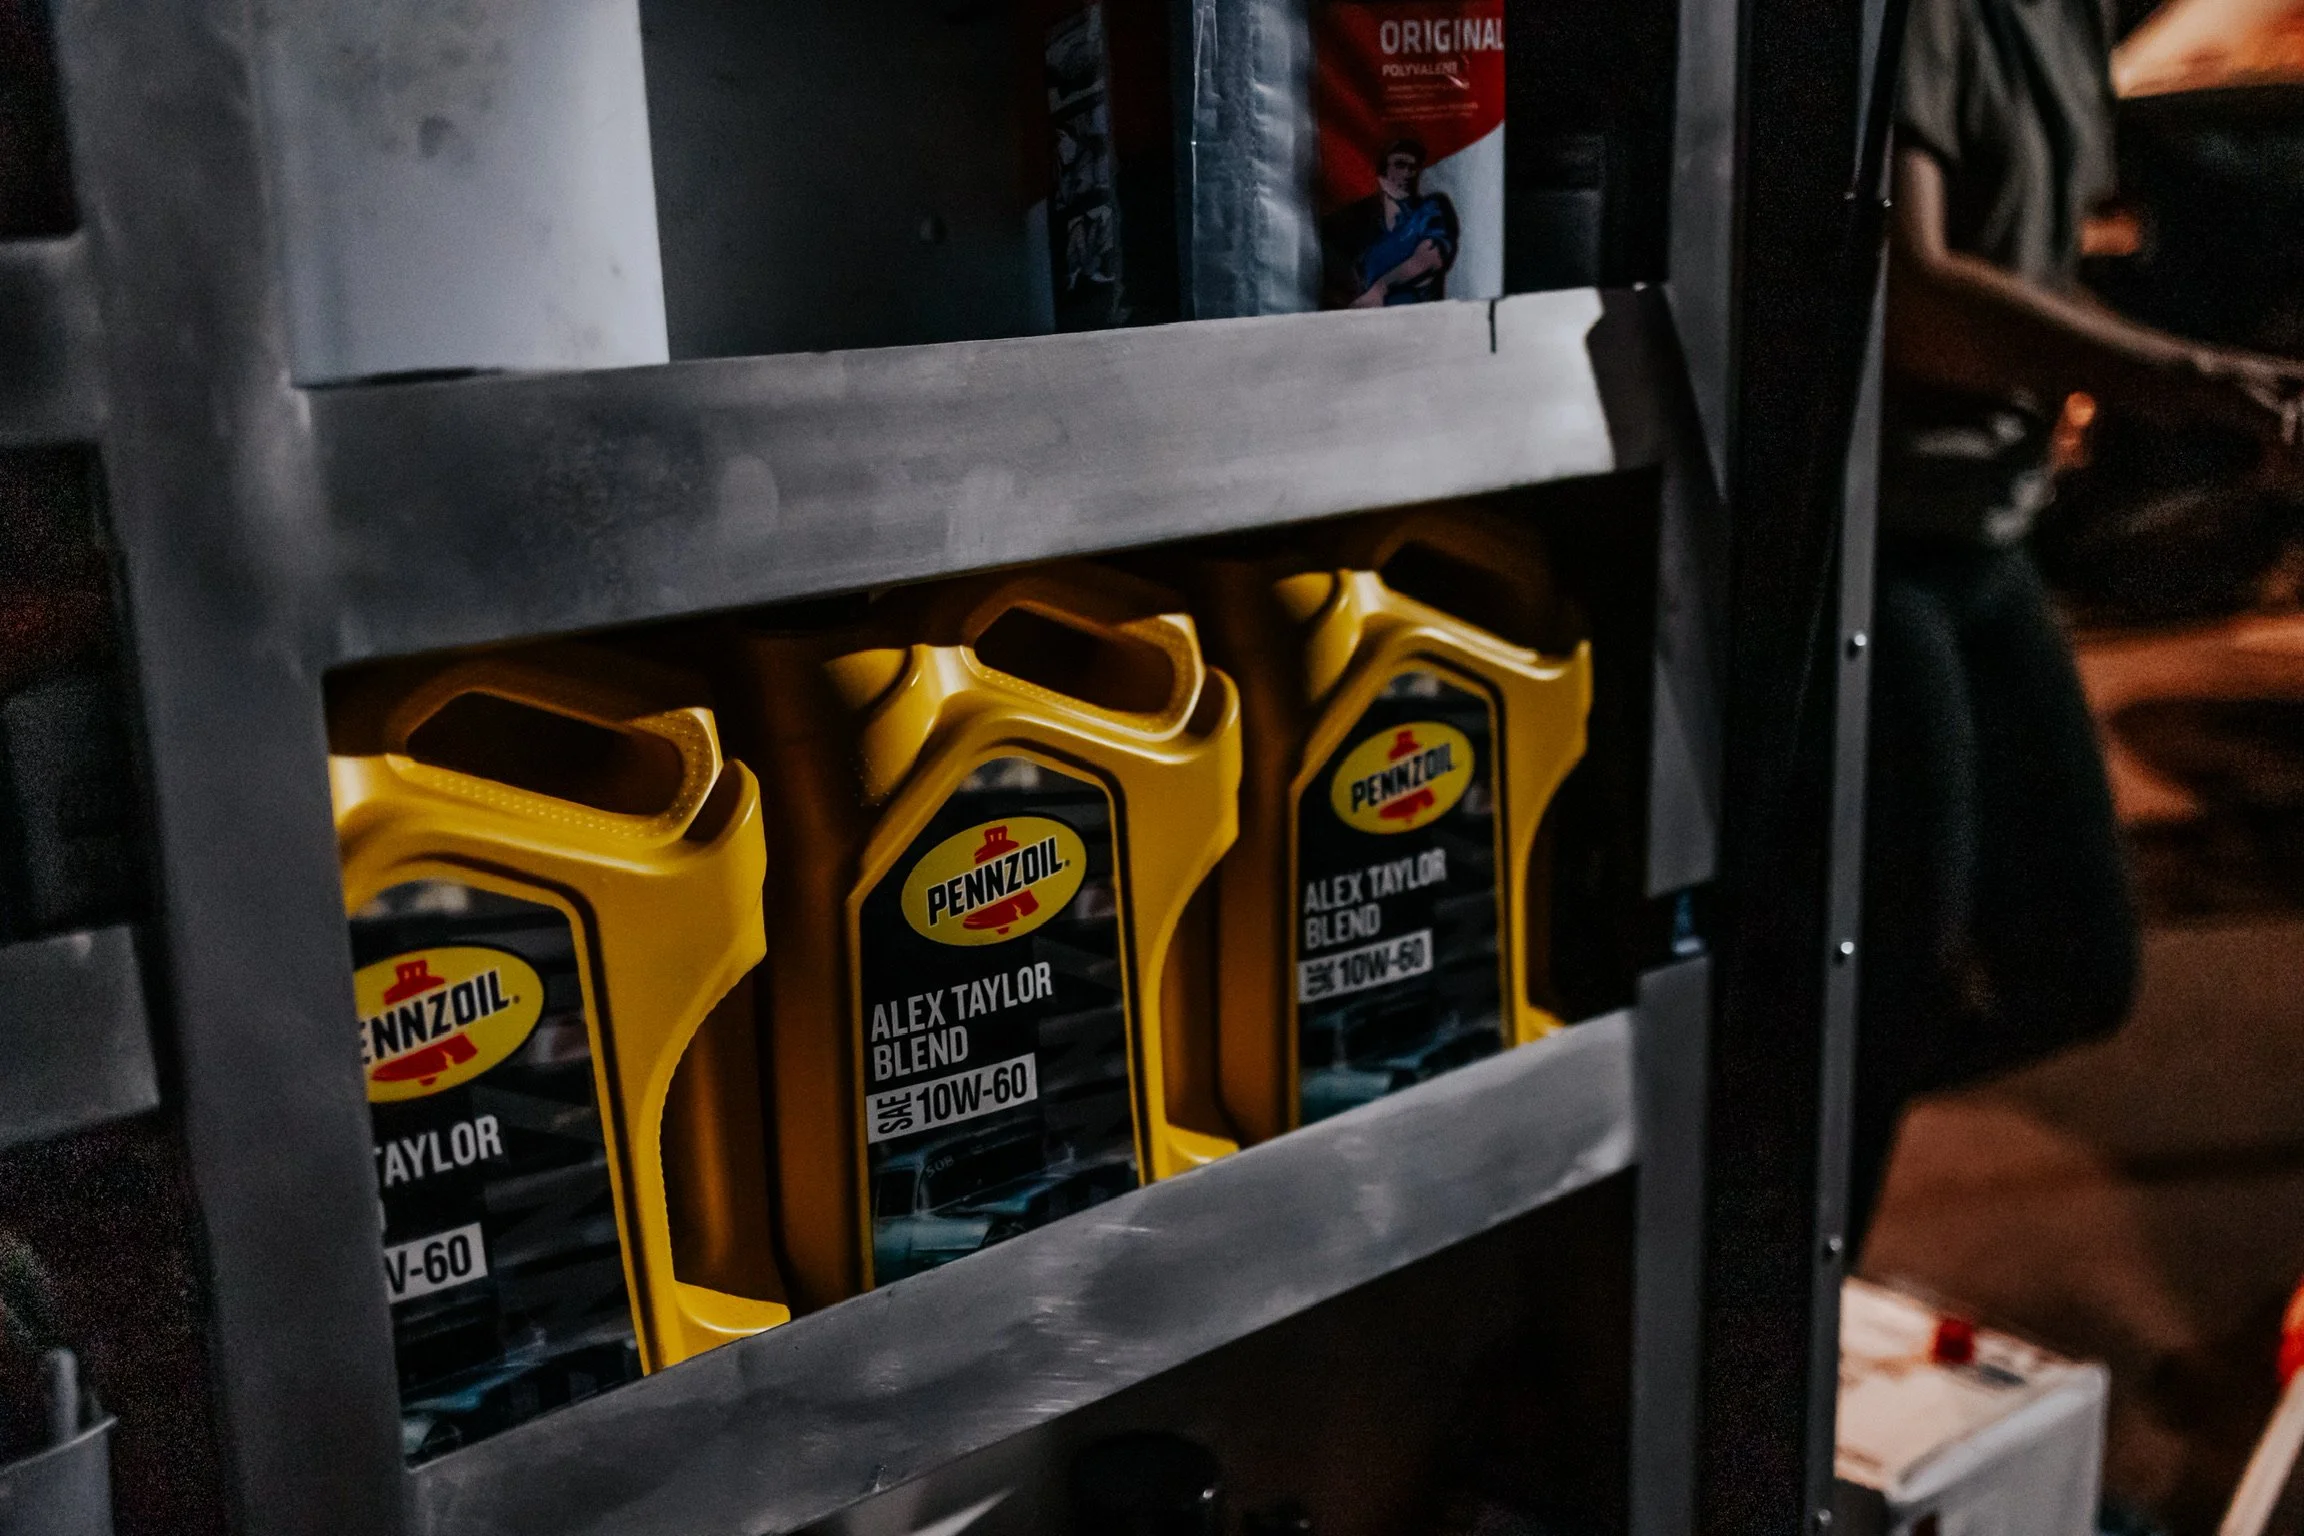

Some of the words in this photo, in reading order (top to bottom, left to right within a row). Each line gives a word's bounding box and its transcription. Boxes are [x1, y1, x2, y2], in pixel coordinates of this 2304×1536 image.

[1380, 17, 1505, 55] ORIGINAL
[1351, 743, 1455, 813] PENNZOIL
[926, 836, 1063, 927] PENNZOIL
[1303, 868, 1365, 915] ALEX
[1366, 846, 1448, 899] TAYLOR
[1304, 902, 1382, 951] BLEND
[1340, 938, 1426, 987] 10W-60
[358, 970, 509, 1065] NNZOIL
[871, 989, 947, 1042] ALEX
[950, 961, 1053, 1021] TAYLOR
[872, 1025, 969, 1083] BLEND
[877, 1092, 913, 1135] SAE
[916, 1062, 1028, 1124] 10W-60
